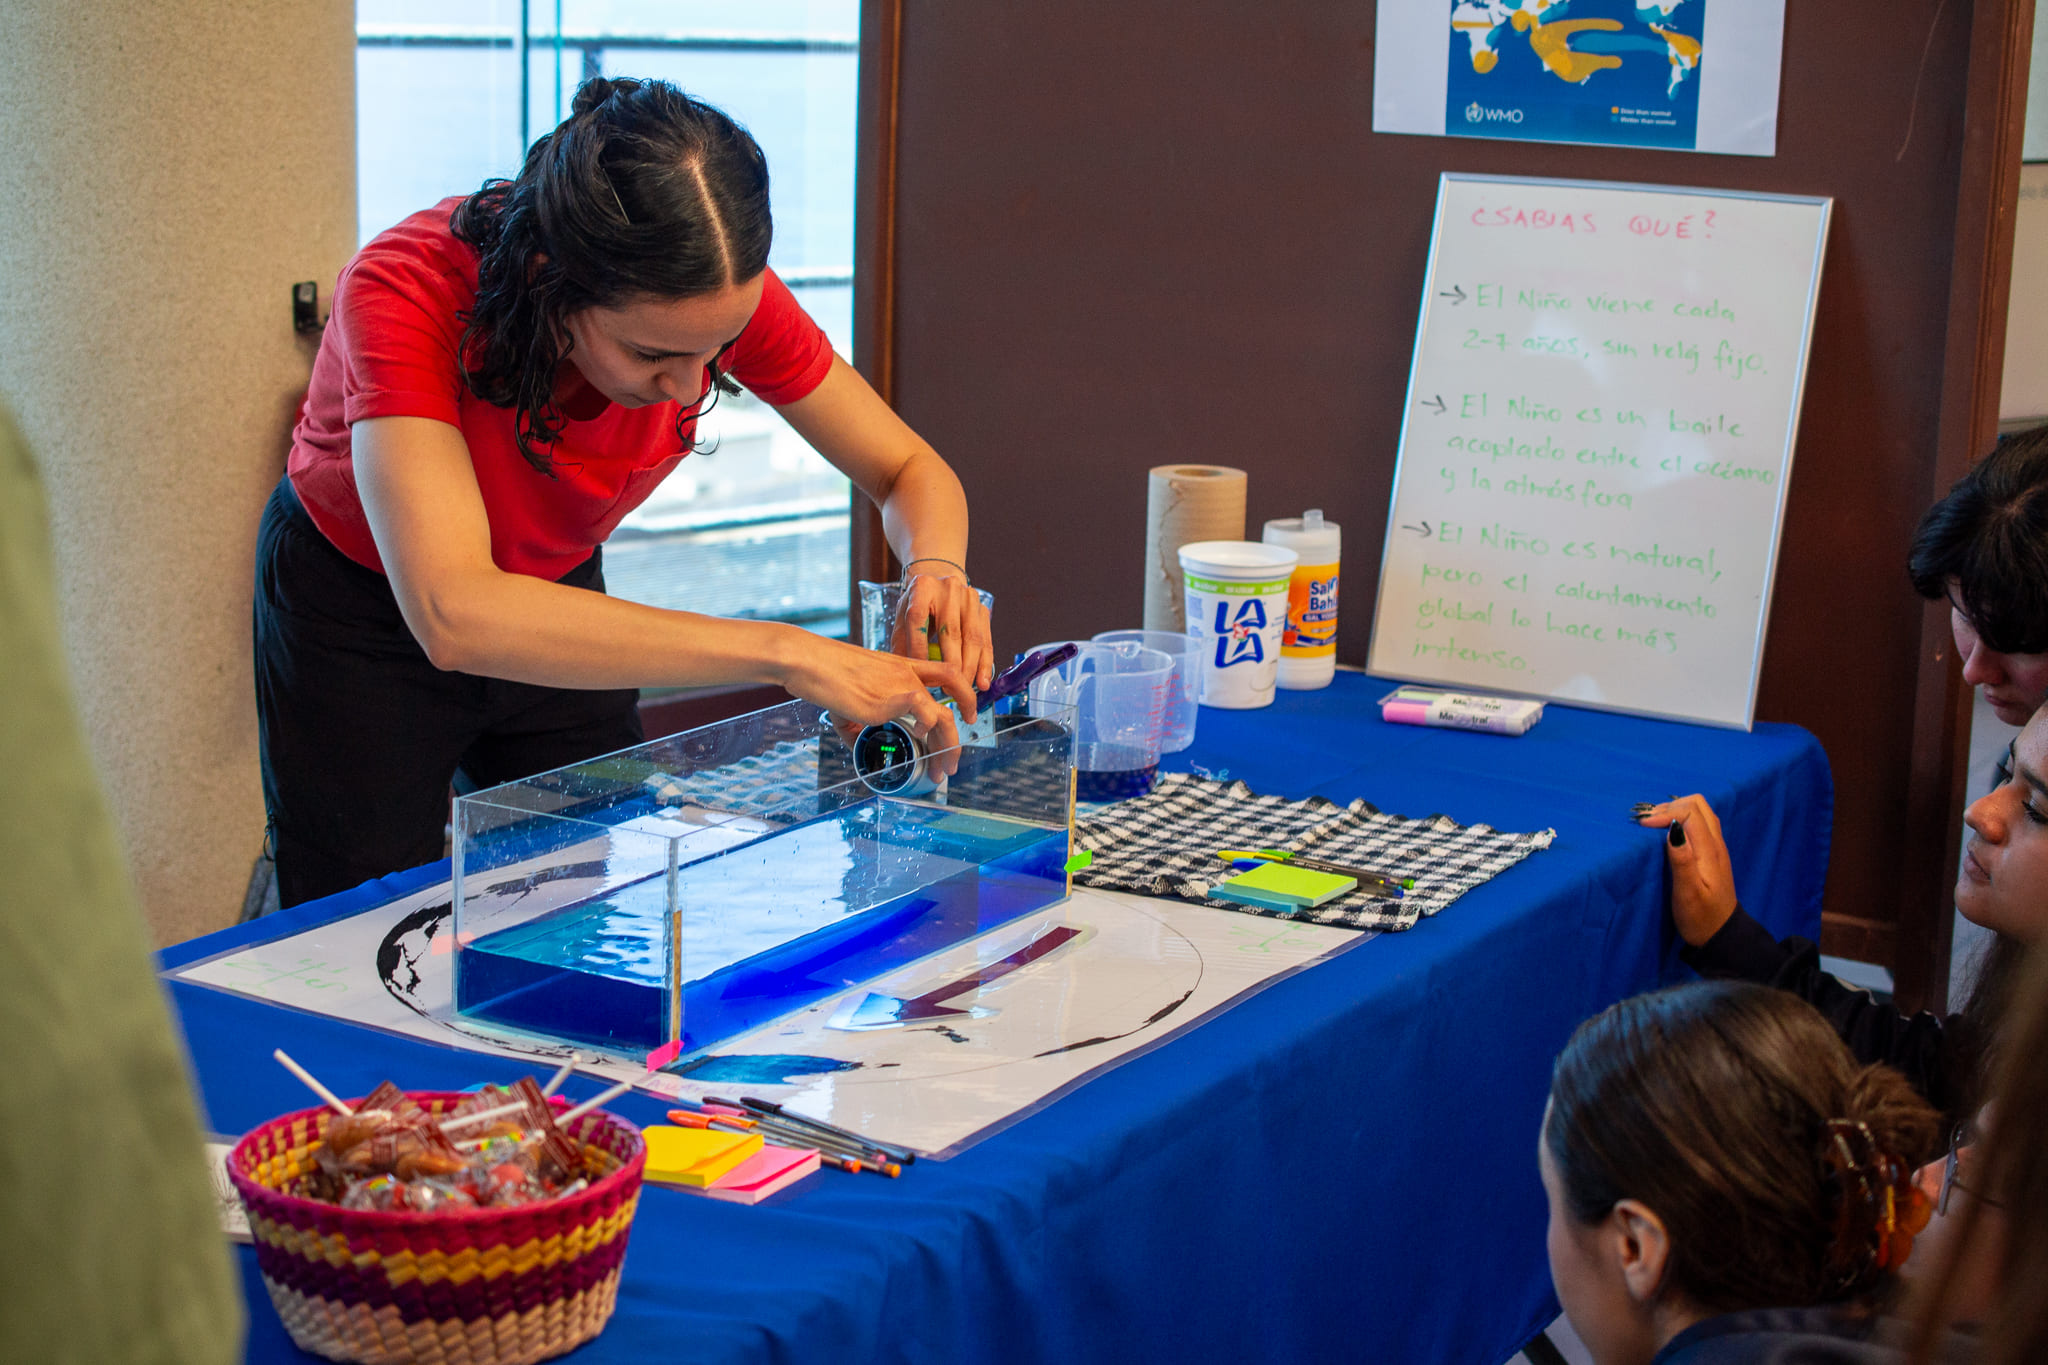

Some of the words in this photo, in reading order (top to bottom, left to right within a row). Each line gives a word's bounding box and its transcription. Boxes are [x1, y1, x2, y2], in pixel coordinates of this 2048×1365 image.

[1485, 109, 1523, 123] WMO
[1628, 205, 1716, 239] QUÉ?
[1477, 283, 1503, 308] El
[1518, 289, 1572, 311] Niño
[1587, 294, 1654, 313] viene
[1673, 299, 1735, 322] cada
[1463, 329, 1510, 352] 2-7
[1522, 336, 1590, 359] años,
[1602, 339, 1638, 359] sin
[1713, 339, 1768, 380] fijo.
[1460, 392, 1487, 418] El
[1508, 396, 1562, 423] Niño
[1576, 407, 1602, 424] es
[1617, 410, 1646, 429] un
[1669, 409, 1744, 438] baile
[1447, 435, 1565, 463] acoplado
[1576, 446, 1640, 469] entre
[1660, 456, 1682, 473] el
[1440, 467, 1456, 494] y
[1471, 467, 1491, 491] la
[1504, 474, 1633, 510] atmósfera
[1438, 521, 1463, 545] El
[1480, 523, 1550, 555] Niño
[1562, 542, 1598, 560] es
[1610, 543, 1722, 584] natural,
[1421, 563, 1483, 588] pero
[1503, 573, 1528, 593] el
[1555, 581, 1717, 619] calentamiento
[1416, 597, 1494, 629] global
[1511, 607, 1532, 628] lo
[1547, 611, 1606, 642] hace
[1617, 627, 1677, 653] más
